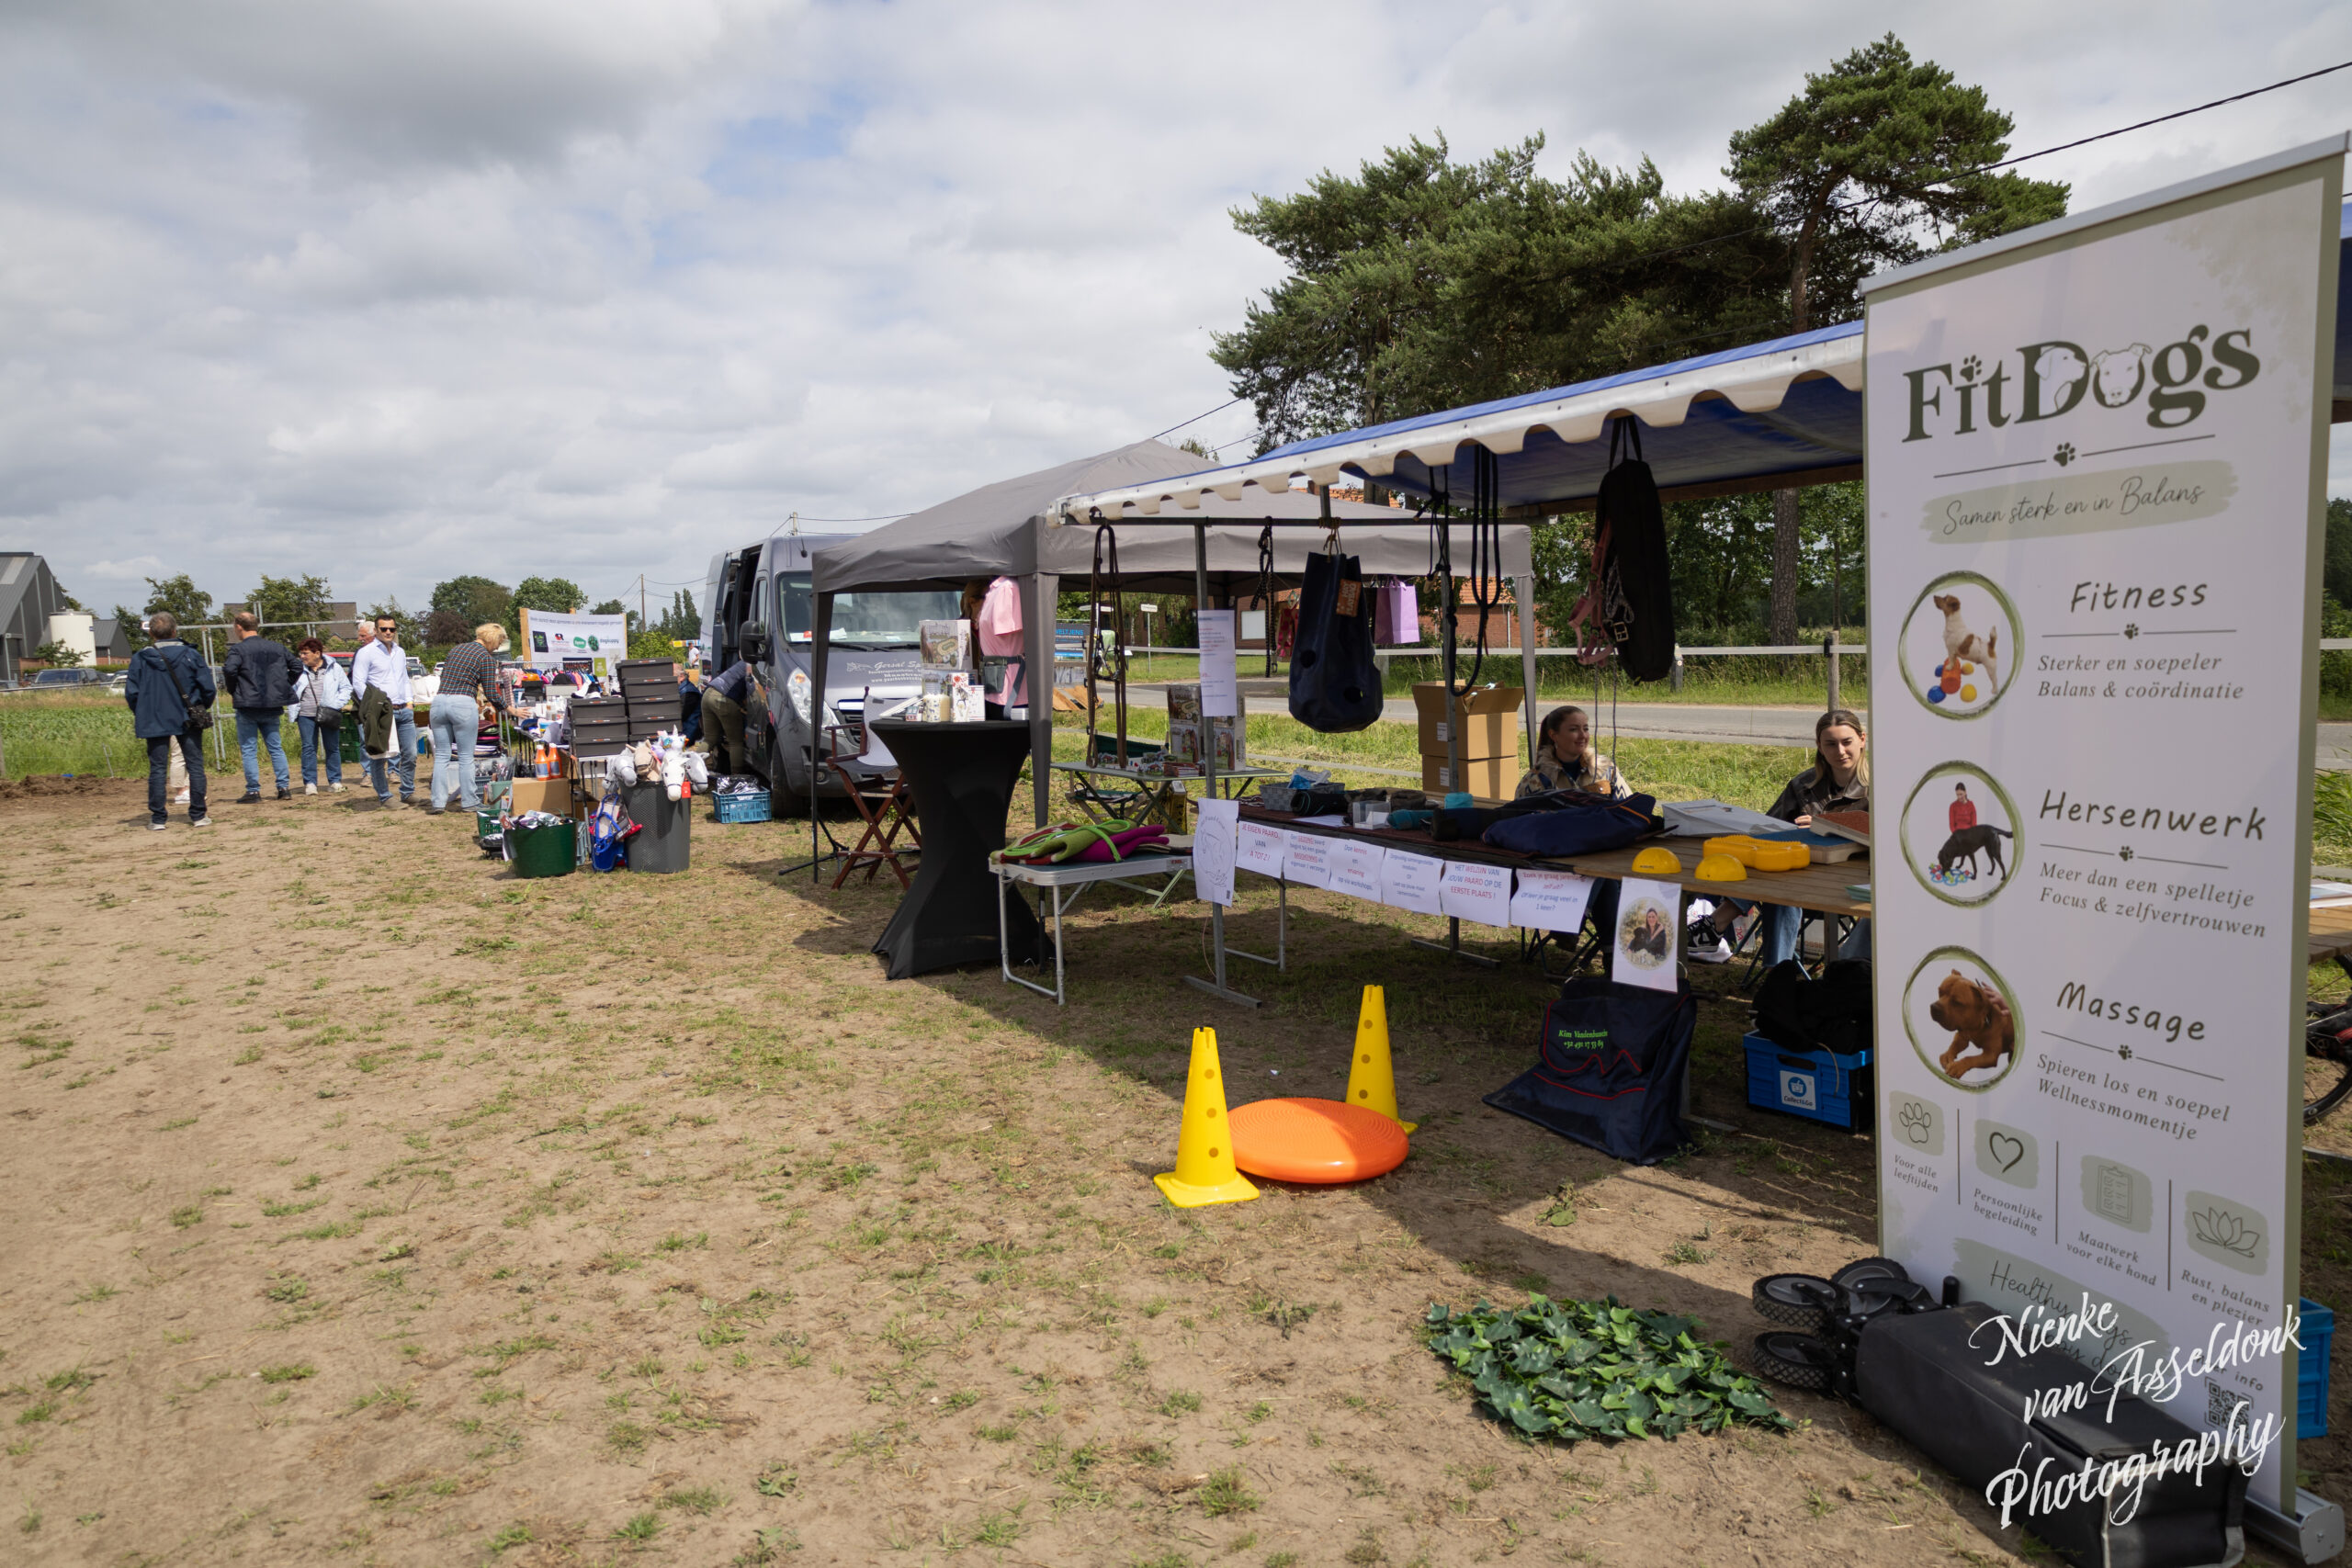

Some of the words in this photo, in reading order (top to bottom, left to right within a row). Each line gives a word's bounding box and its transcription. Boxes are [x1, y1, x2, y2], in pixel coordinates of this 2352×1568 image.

[1902, 324, 2260, 443] FitDogs
[1943, 500, 2004, 536] Samen
[2008, 492, 2059, 525] sterk
[2064, 502, 2088, 515] en
[2093, 494, 2113, 511] in
[2120, 476, 2205, 515] Balans
[2070, 581, 2208, 613] Fitness
[2038, 654, 2101, 671] Sterker
[2107, 658, 2127, 671] en
[2133, 652, 2222, 675] soepeler
[2038, 681, 2097, 697] Balans
[2103, 681, 2116, 698] &
[2125, 681, 2245, 699] coördinatie
[2039, 789, 2267, 840] Hersenwerk
[1464, 876, 1484, 886] PAARD
[1487, 868, 1500, 876] VAN
[2039, 862, 2082, 882] Meer
[2086, 869, 2118, 888] dan
[2125, 878, 2157, 894] een
[2165, 883, 2255, 909] spelletje
[1450, 886, 1470, 896] EERSTE
[1471, 889, 1493, 899] PLAATS
[2040, 886, 2087, 908] Focus
[2094, 896, 2109, 913] &
[2115, 901, 2267, 938] zelfvertrouwen
[2056, 981, 2206, 1042] Massage
[1558, 1029, 1572, 1038] Kim
[2037, 1053, 2097, 1085] Spieren
[2103, 1072, 2130, 1094] los
[2137, 1087, 2158, 1102] en
[2165, 1094, 2231, 1122] soepel
[2038, 1077, 2198, 1141] Wellnessmomentje
[1894, 1154, 1916, 1169] Voor
[1917, 1166, 1938, 1179] alle
[1894, 1168, 1939, 1193] leeftijden
[1973, 1201, 2038, 1236] begeleiding
[1974, 1188, 2043, 1222] Persoonlijke
[2077, 1231, 2140, 1263] Maatwerk
[2066, 1243, 2093, 1259] voor
[2096, 1255, 2122, 1271] elke
[2126, 1264, 2157, 1286] hond
[2181, 1269, 2216, 1293] Rust,
[2221, 1283, 2270, 1313] balans
[2191, 1292, 2208, 1305] en
[2211, 1300, 2264, 1326] plezier
[2234, 1371, 2264, 1392] info
